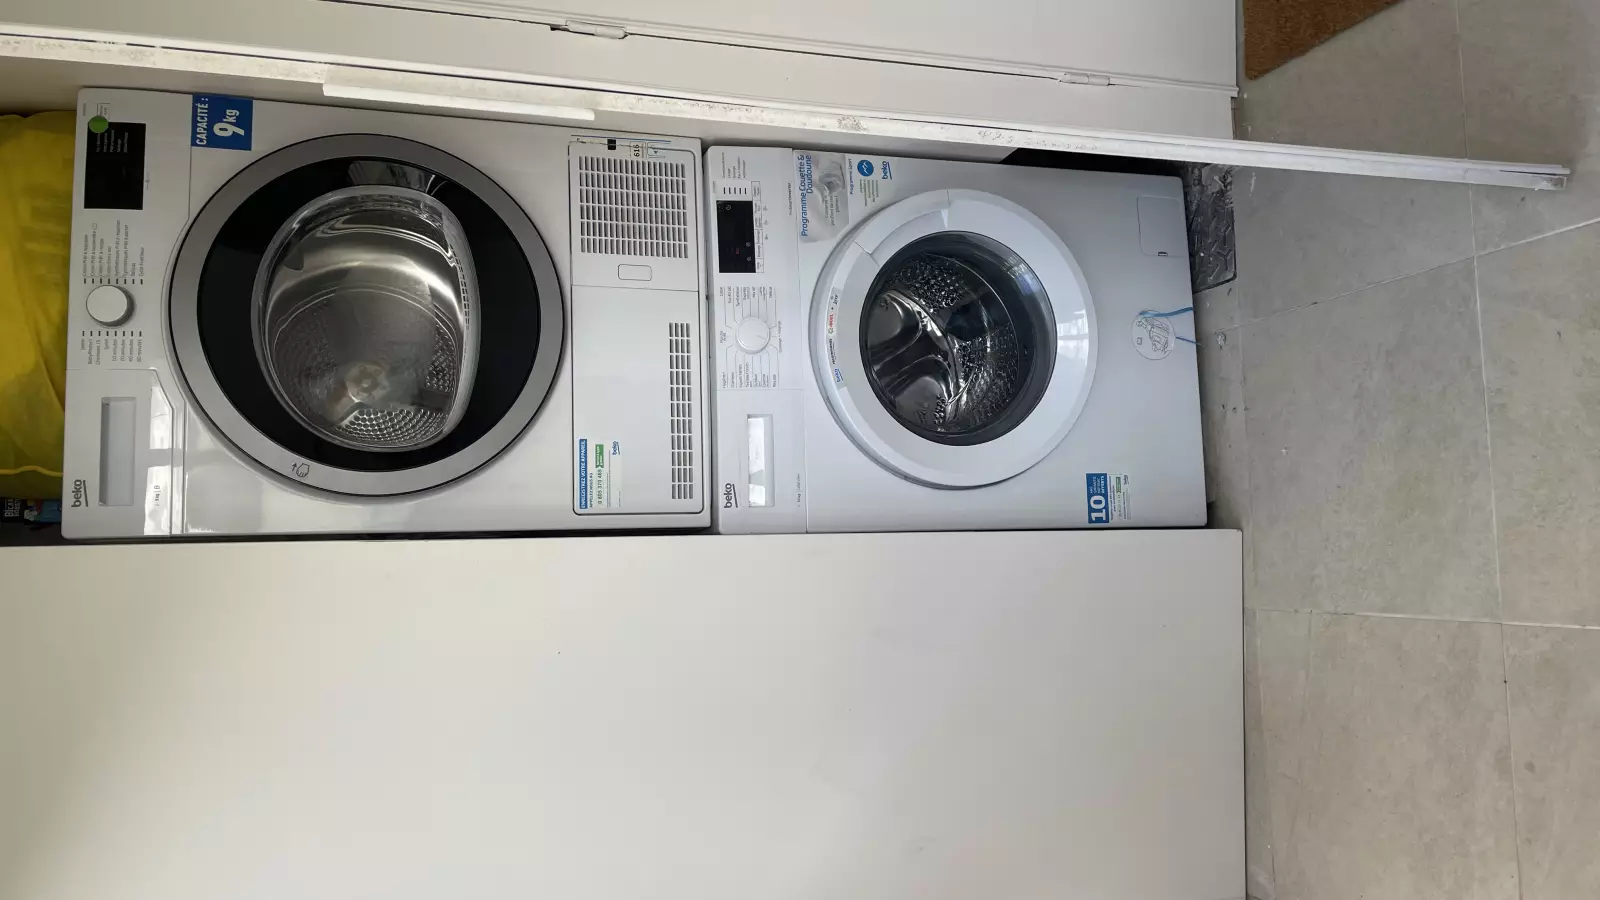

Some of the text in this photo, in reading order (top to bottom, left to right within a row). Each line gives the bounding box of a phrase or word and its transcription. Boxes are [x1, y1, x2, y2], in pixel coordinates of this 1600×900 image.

[195, 103, 208, 145] CAPACITÉ
[212, 109, 245, 137] 9 kg
[800, 192, 810, 236] Programme
[72, 479, 83, 507] beko
[724, 483, 732, 508] beko
[1090, 495, 1106, 521] 10
